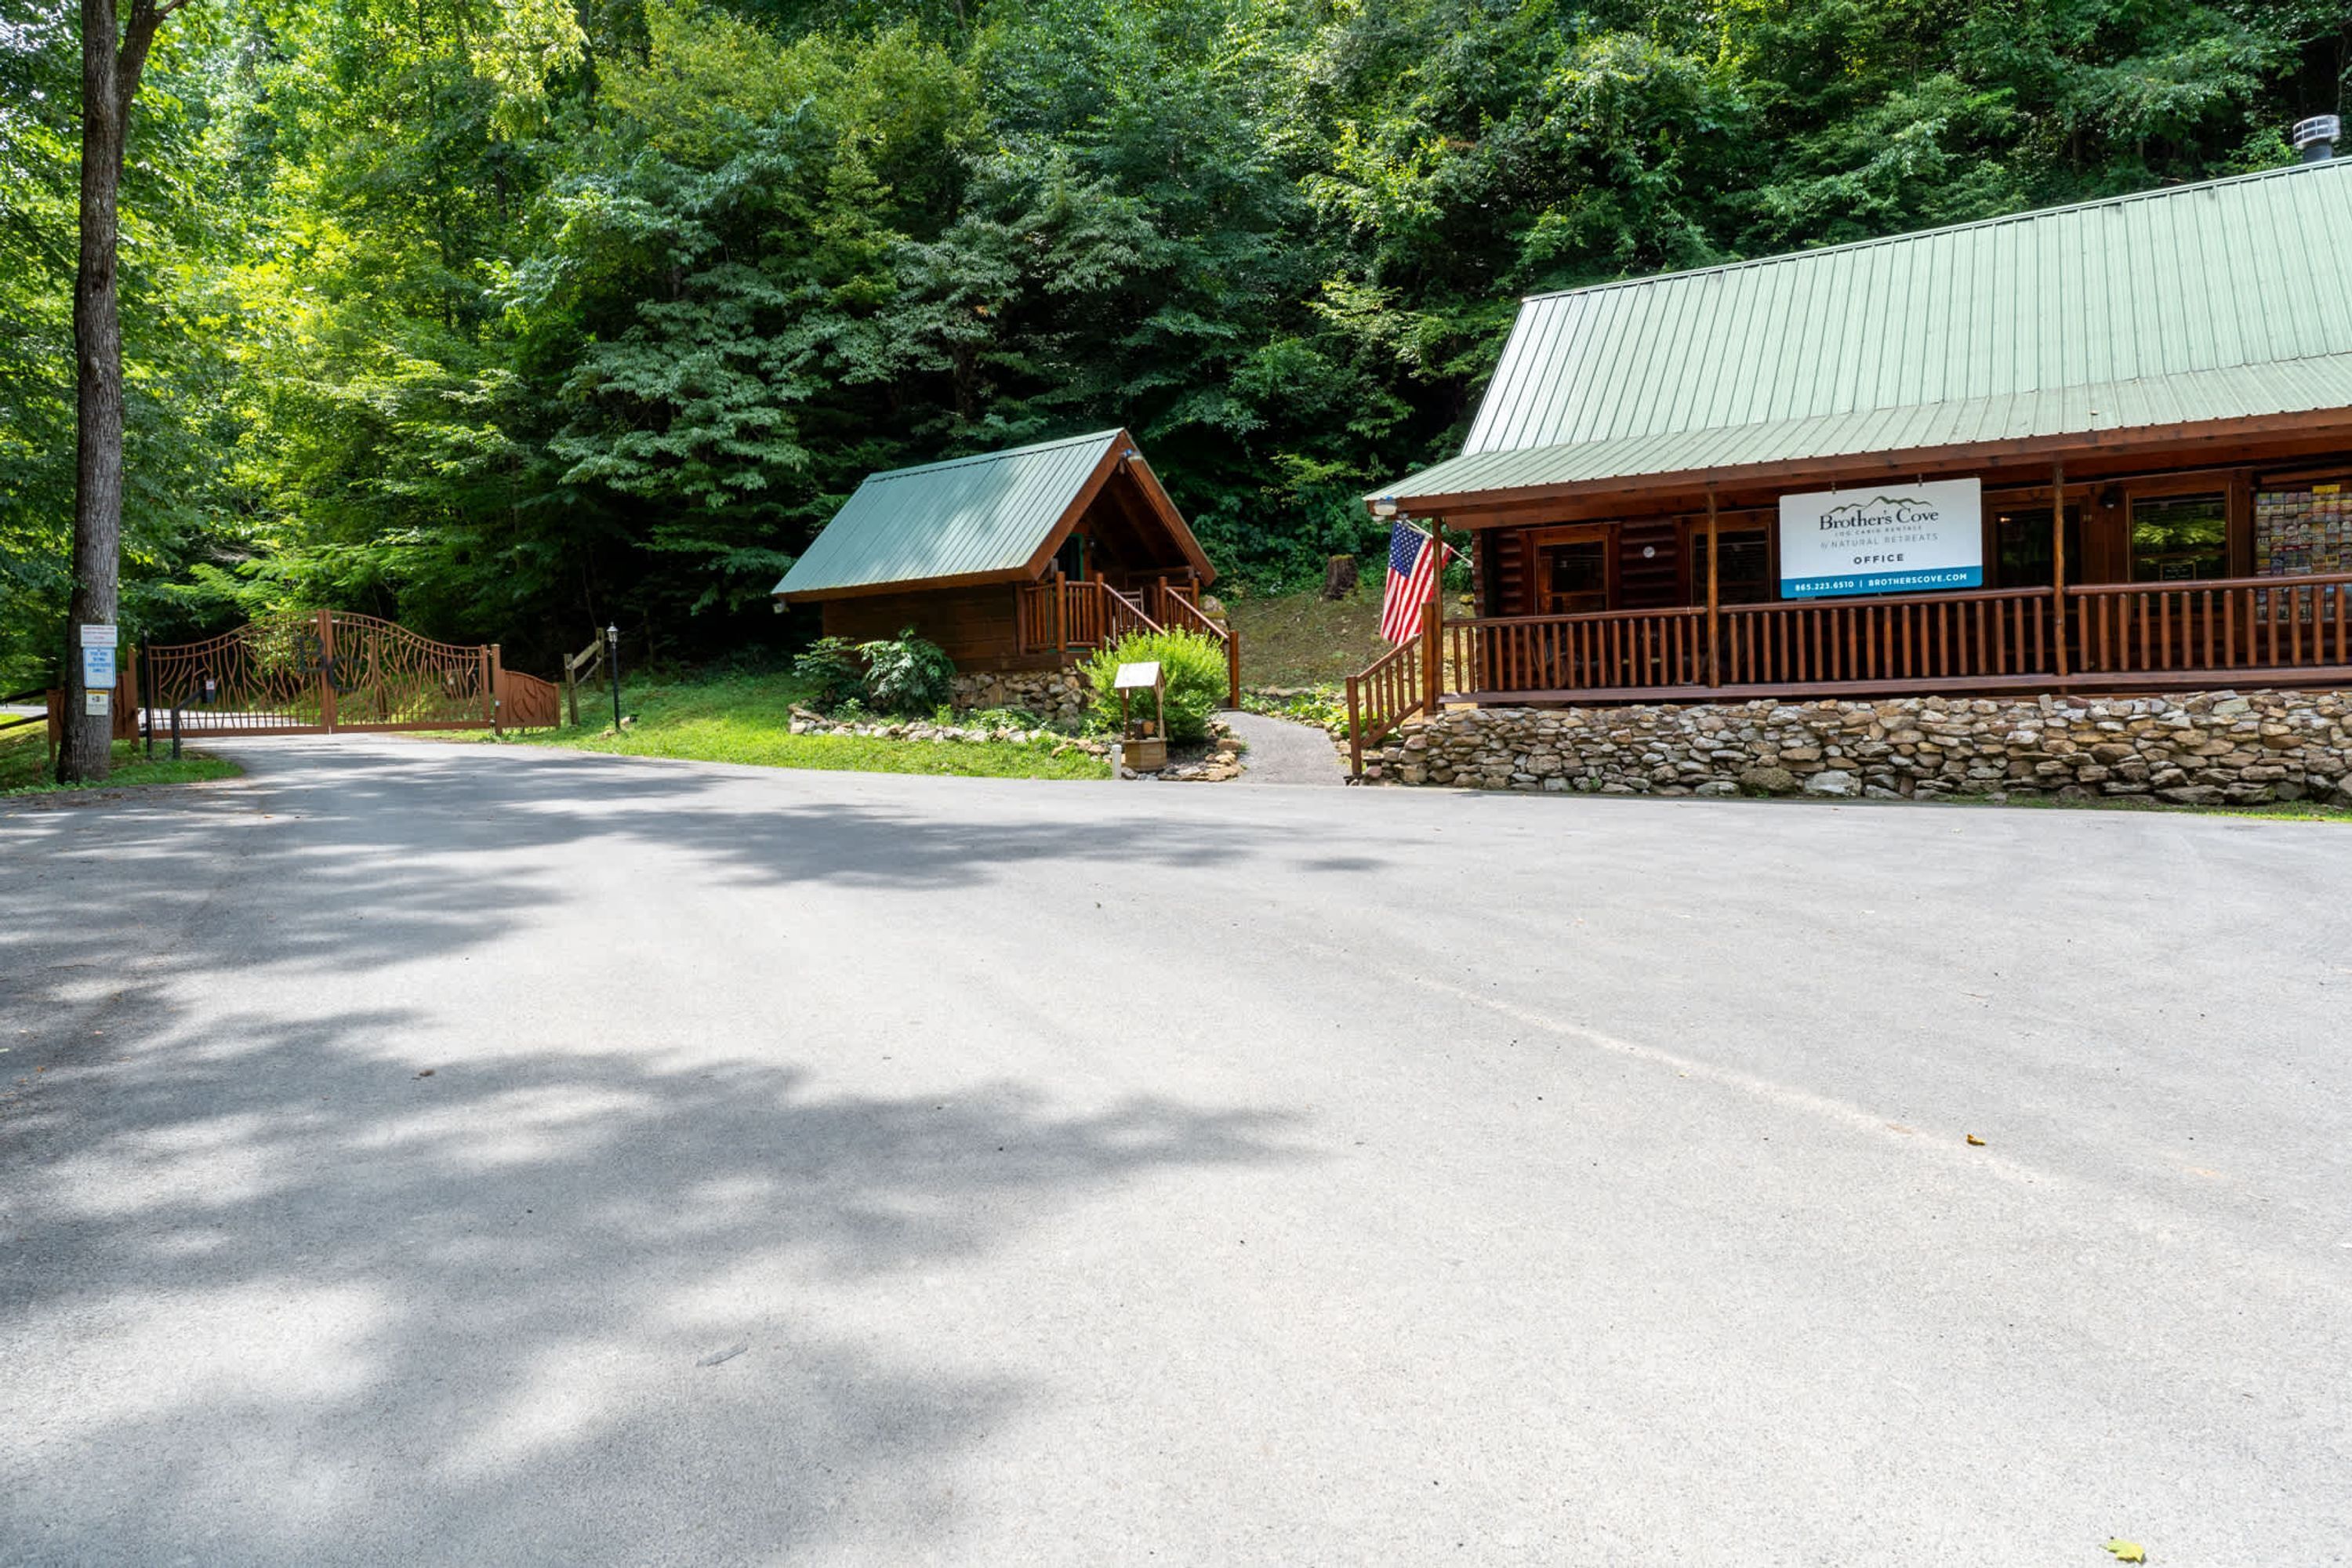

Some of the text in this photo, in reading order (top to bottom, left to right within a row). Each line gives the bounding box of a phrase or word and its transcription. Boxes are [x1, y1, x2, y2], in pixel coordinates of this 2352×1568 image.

[1820, 507, 1939, 531] Brother's Cove
[1831, 537, 1878, 548] NATURAL
[1885, 532, 1938, 543] RETREATS
[1853, 554, 1904, 564] OFFICE
[1868, 572, 1967, 587] BROTHERSCOVE.COM
